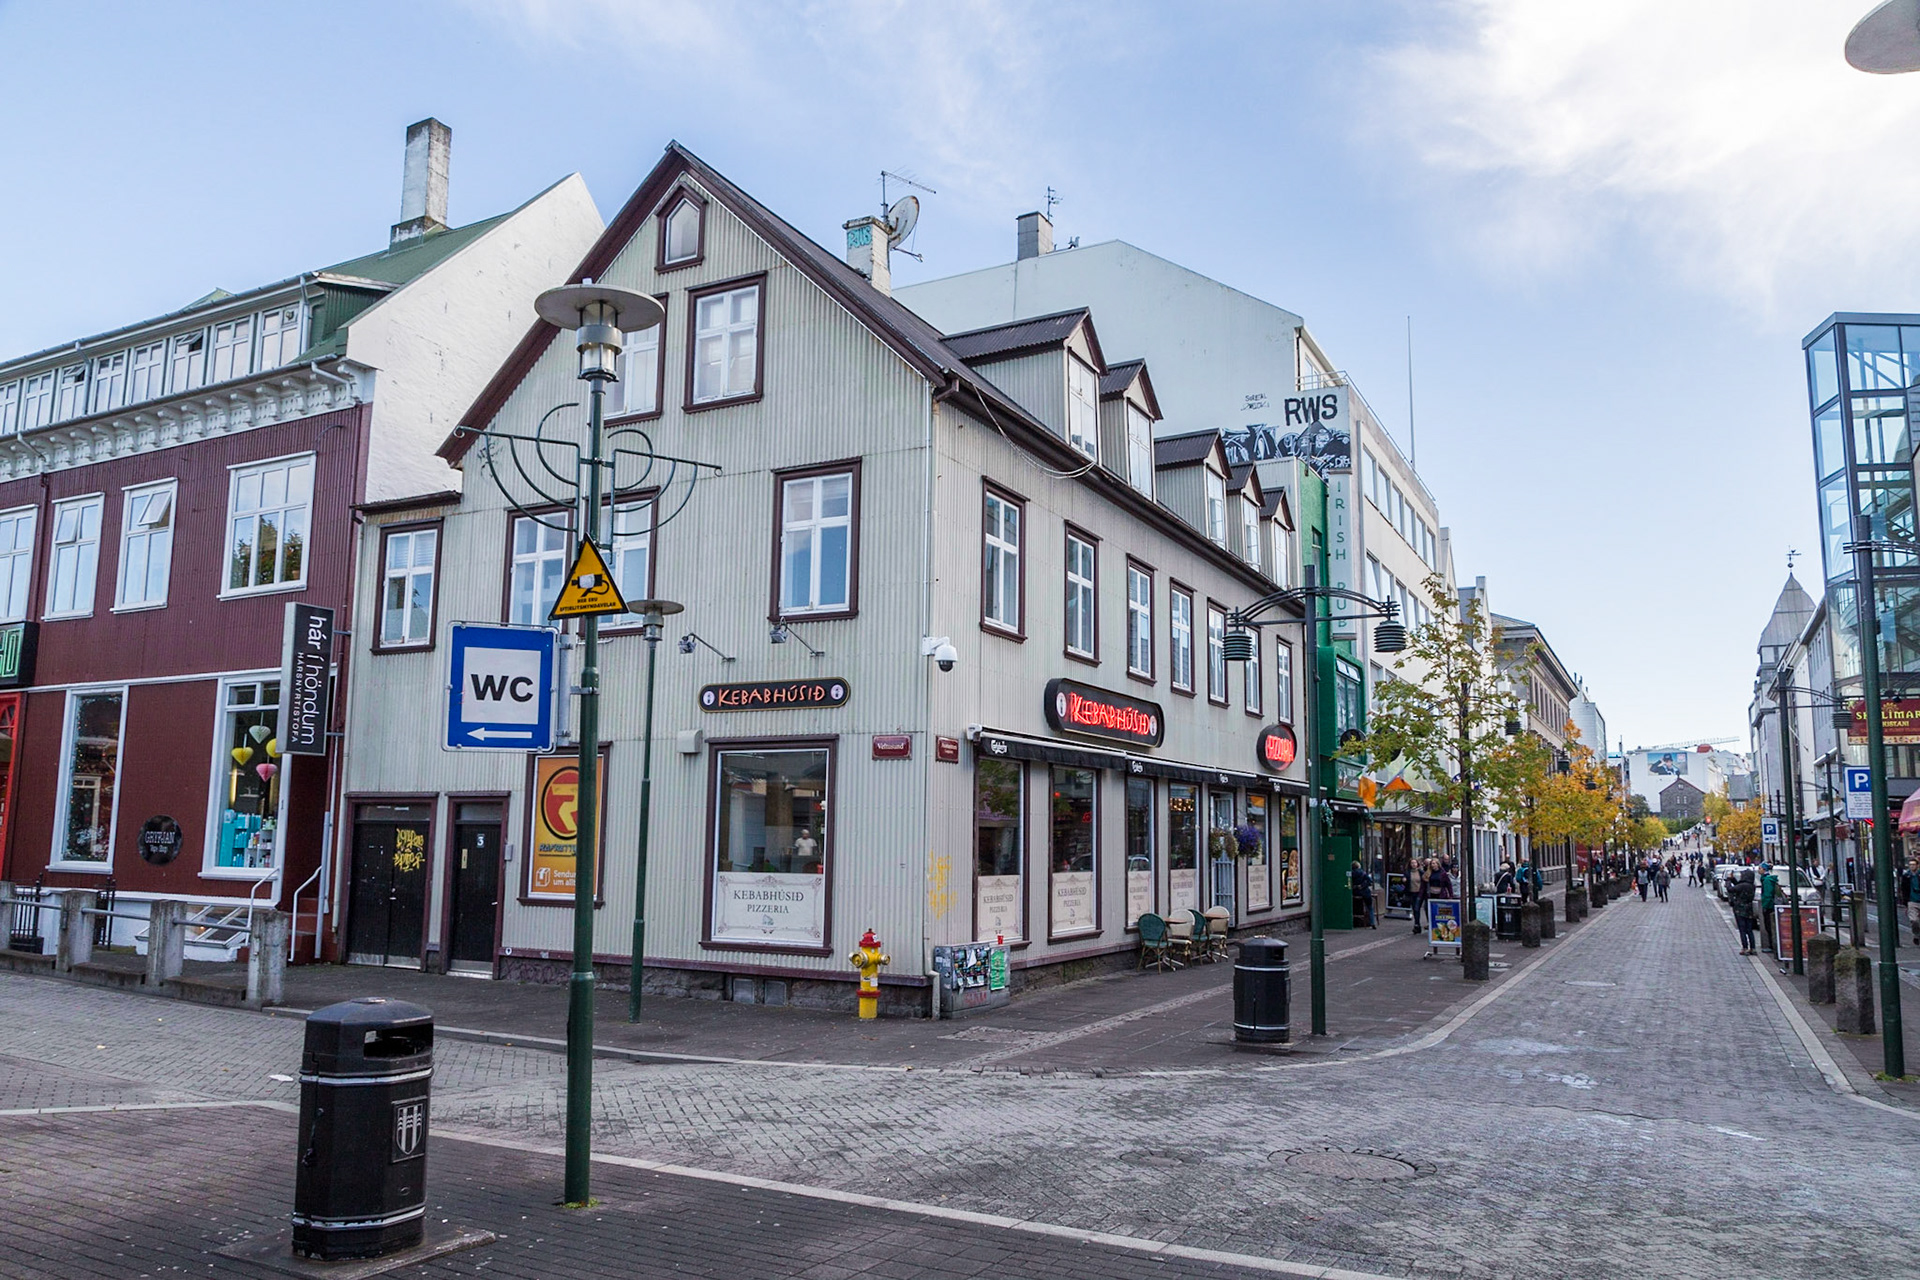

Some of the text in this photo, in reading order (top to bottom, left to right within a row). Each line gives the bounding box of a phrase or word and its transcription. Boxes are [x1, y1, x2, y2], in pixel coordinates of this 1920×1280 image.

[1283, 394, 1338, 427] RWS
[1335, 481, 1346, 560] IRISH
[471, 674, 534, 702] WC
[718, 684, 826, 707] KEBABHÚSIÐ
[301, 665, 323, 745] höndum
[1854, 773, 1869, 789] P
[1766, 825, 1774, 833] P
[476, 836, 484, 846] 3
[733, 889, 804, 902] KEBABHÚSIÐ
[747, 904, 789, 914] PIZZERIA
